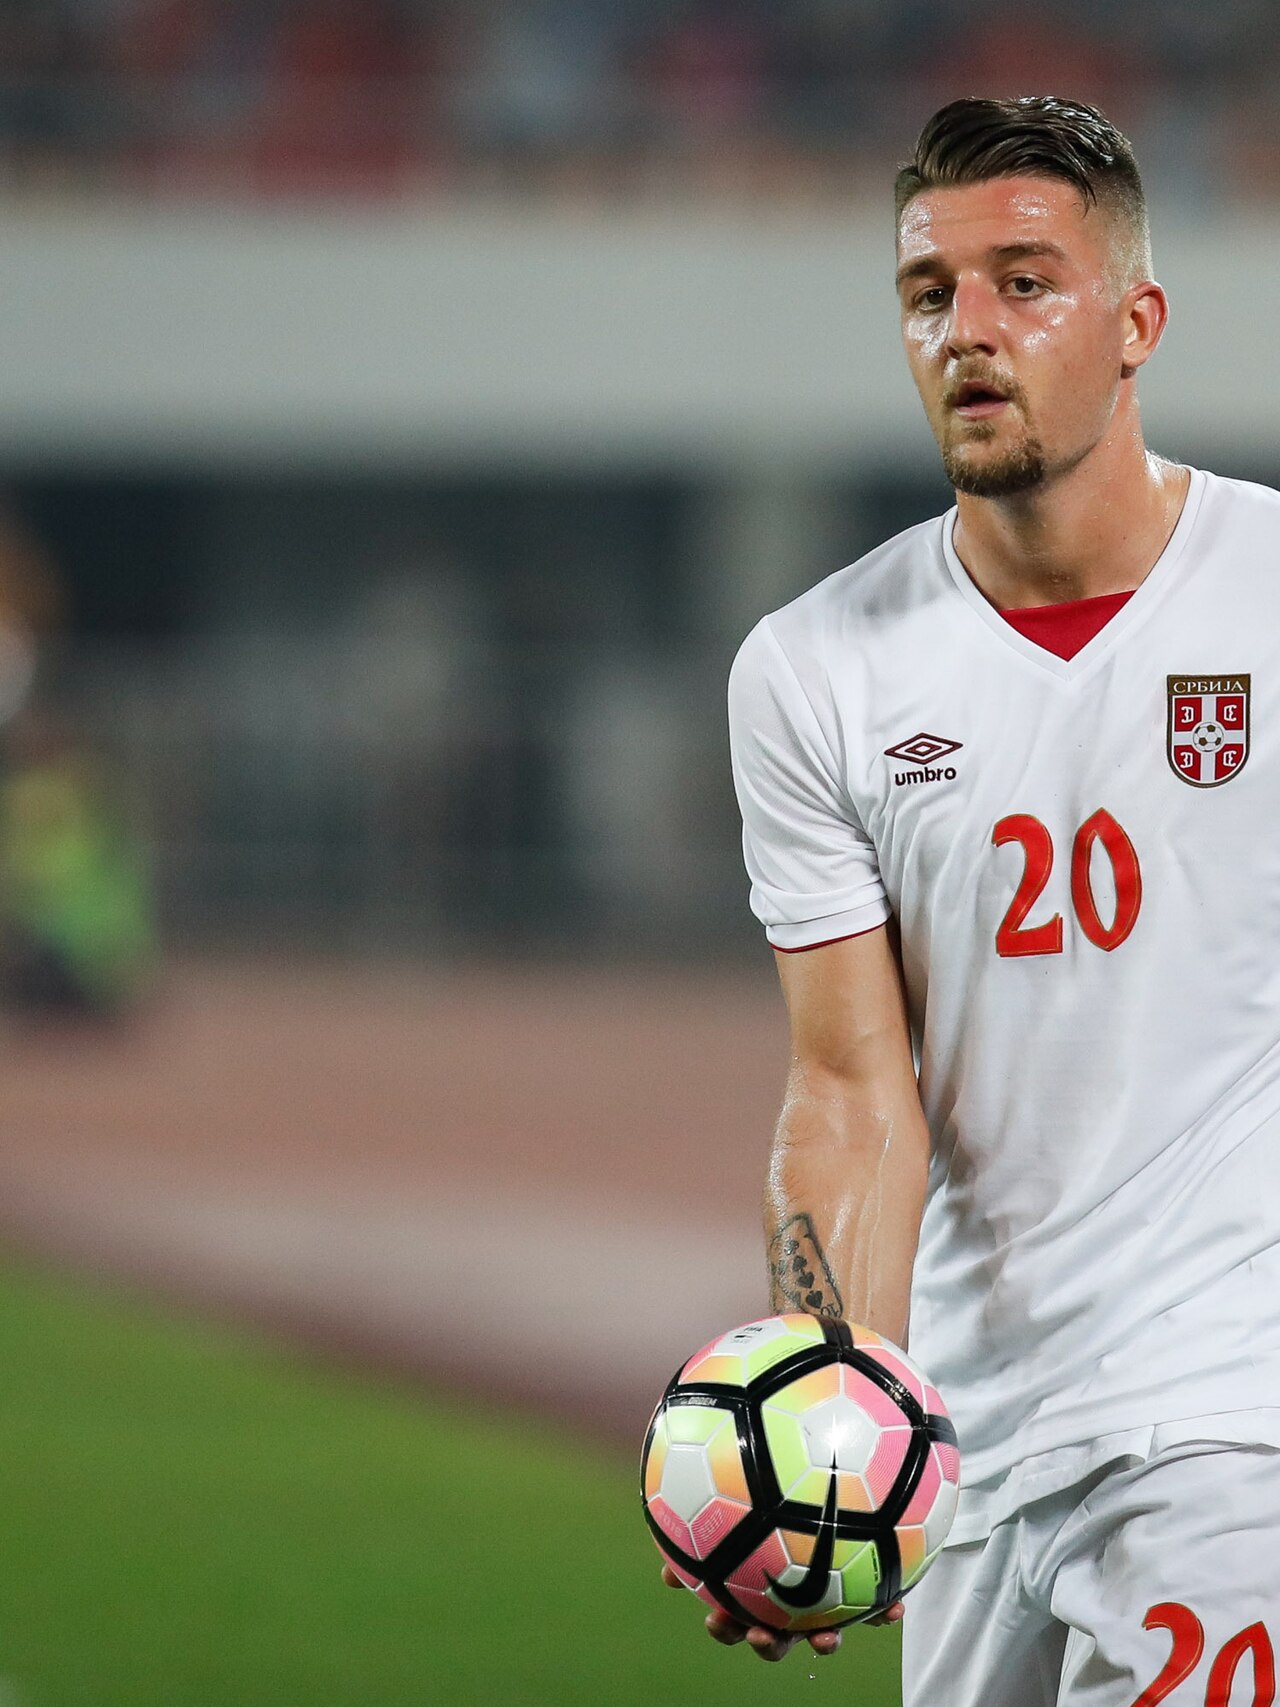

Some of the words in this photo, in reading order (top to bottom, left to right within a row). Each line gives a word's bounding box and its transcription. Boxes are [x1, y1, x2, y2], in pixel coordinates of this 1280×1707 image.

[1173, 680, 1244, 693] СРБИЈА
[894, 766, 957, 786] umbro
[991, 806, 1143, 958] 20
[1129, 1601, 1276, 1707] 20
